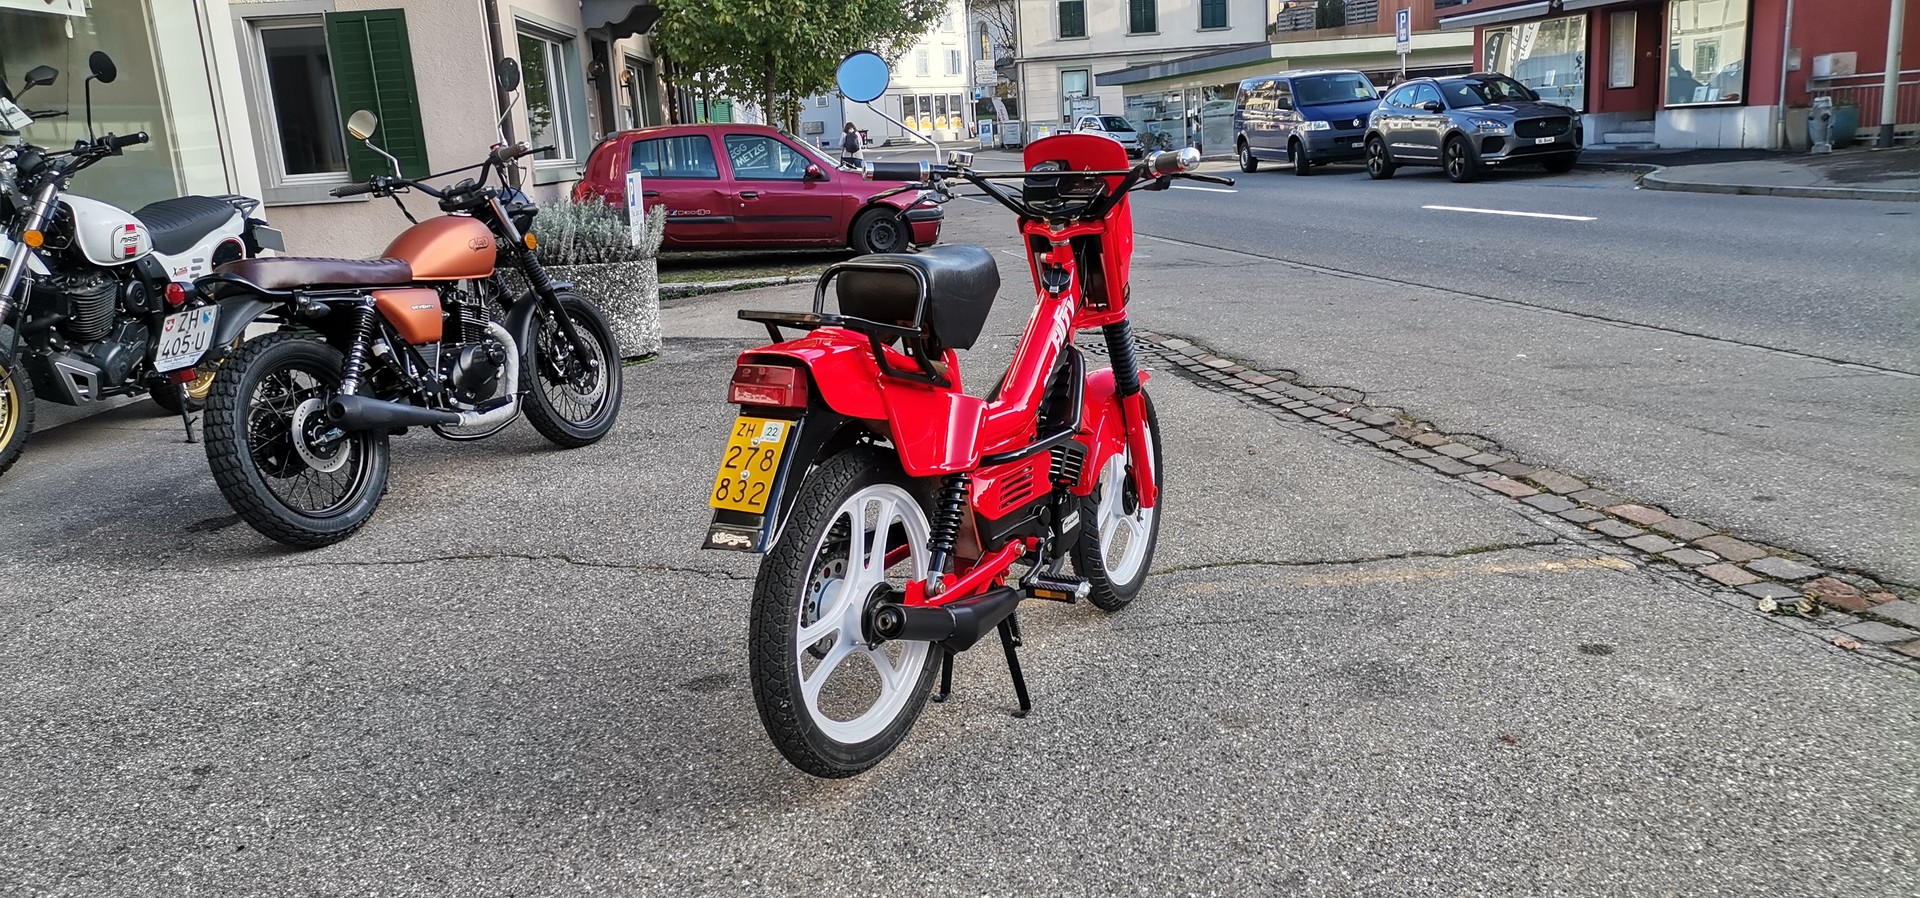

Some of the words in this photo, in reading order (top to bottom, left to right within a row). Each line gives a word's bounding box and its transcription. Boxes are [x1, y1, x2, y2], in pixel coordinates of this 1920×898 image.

[730, 143, 747, 159] EGG
[177, 310, 199, 333] ZH
[737, 422, 756, 437] ZH
[766, 426, 778, 437] 22
[725, 445, 775, 472] 278
[716, 478, 766, 506] 832
